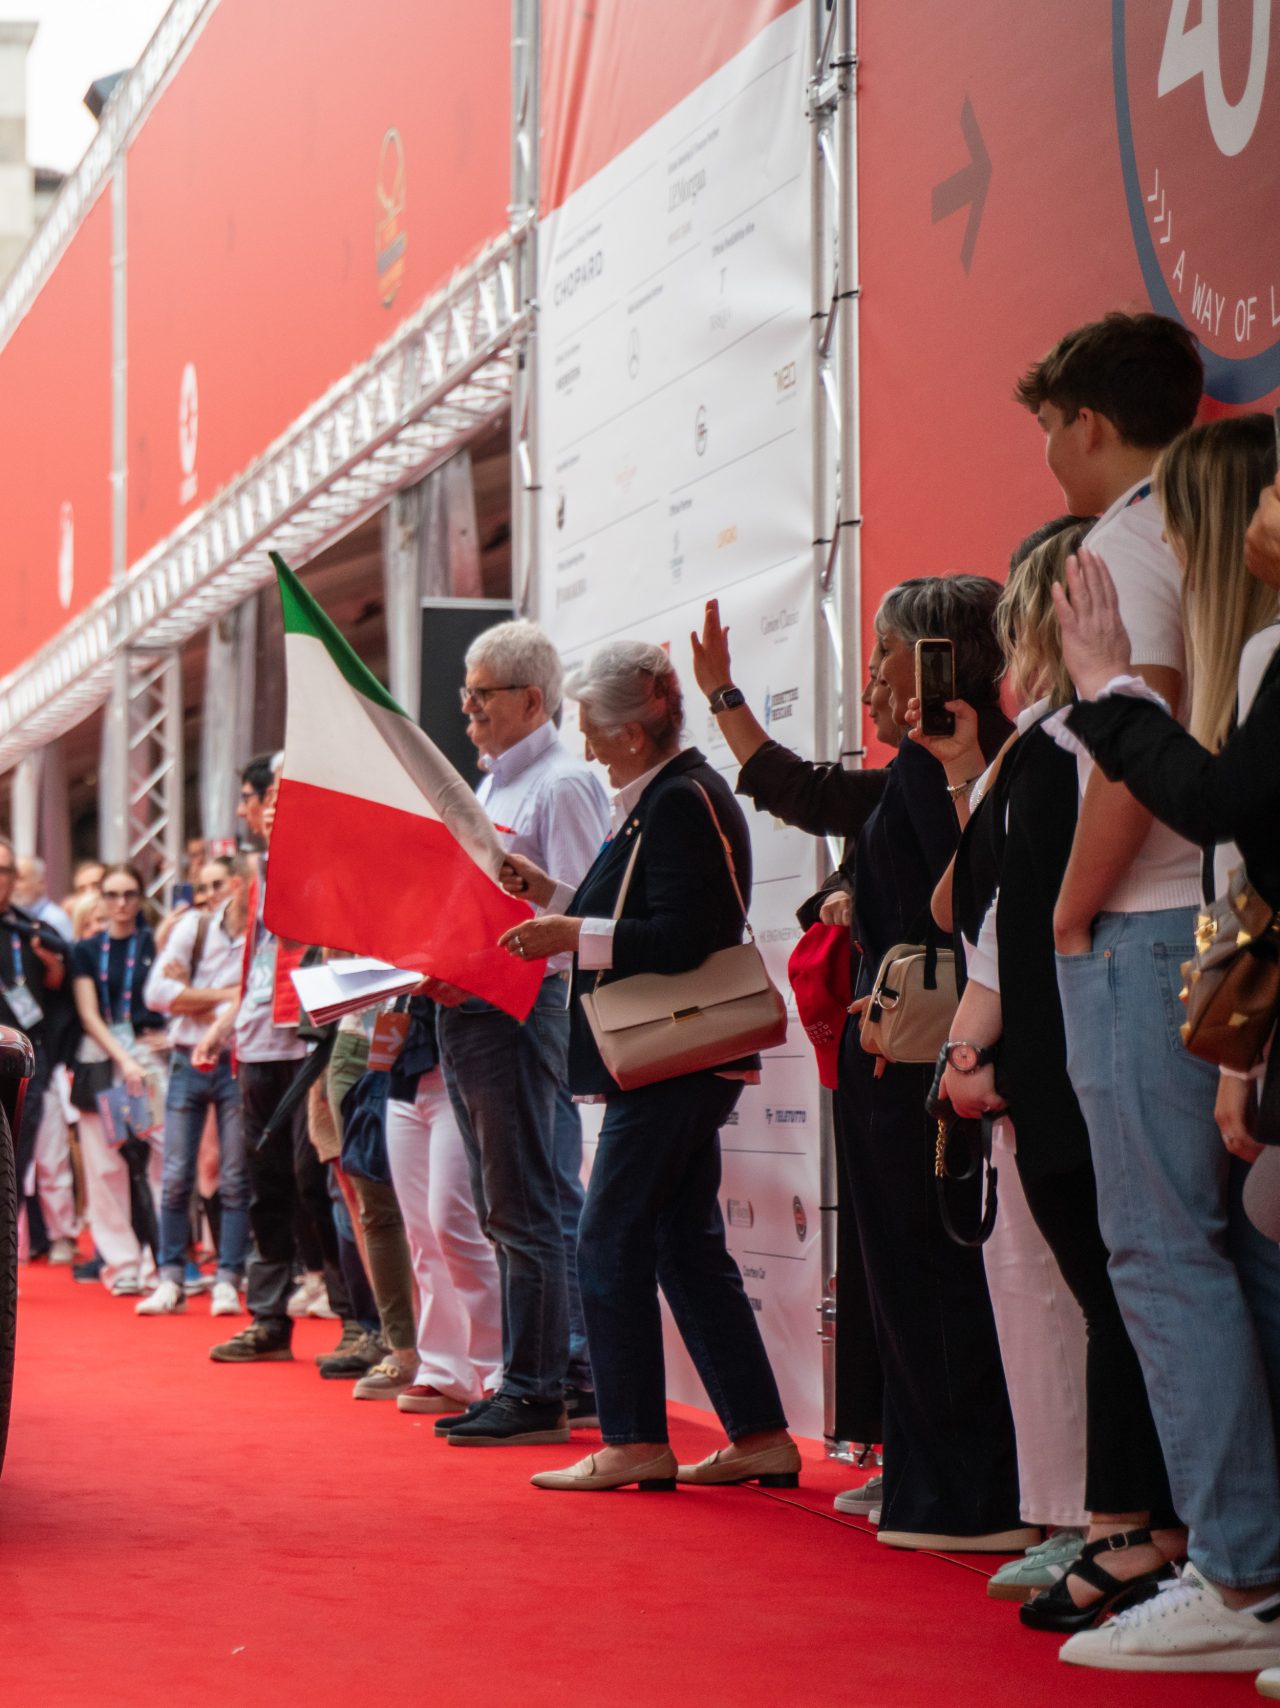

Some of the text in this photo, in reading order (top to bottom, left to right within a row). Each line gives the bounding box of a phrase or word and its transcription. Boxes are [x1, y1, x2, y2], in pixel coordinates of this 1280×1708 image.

[553, 251, 603, 308] CHOPARD
[1172, 250, 1185, 293] A
[1191, 273, 1226, 336] WAY
[1234, 296, 1257, 342] OF
